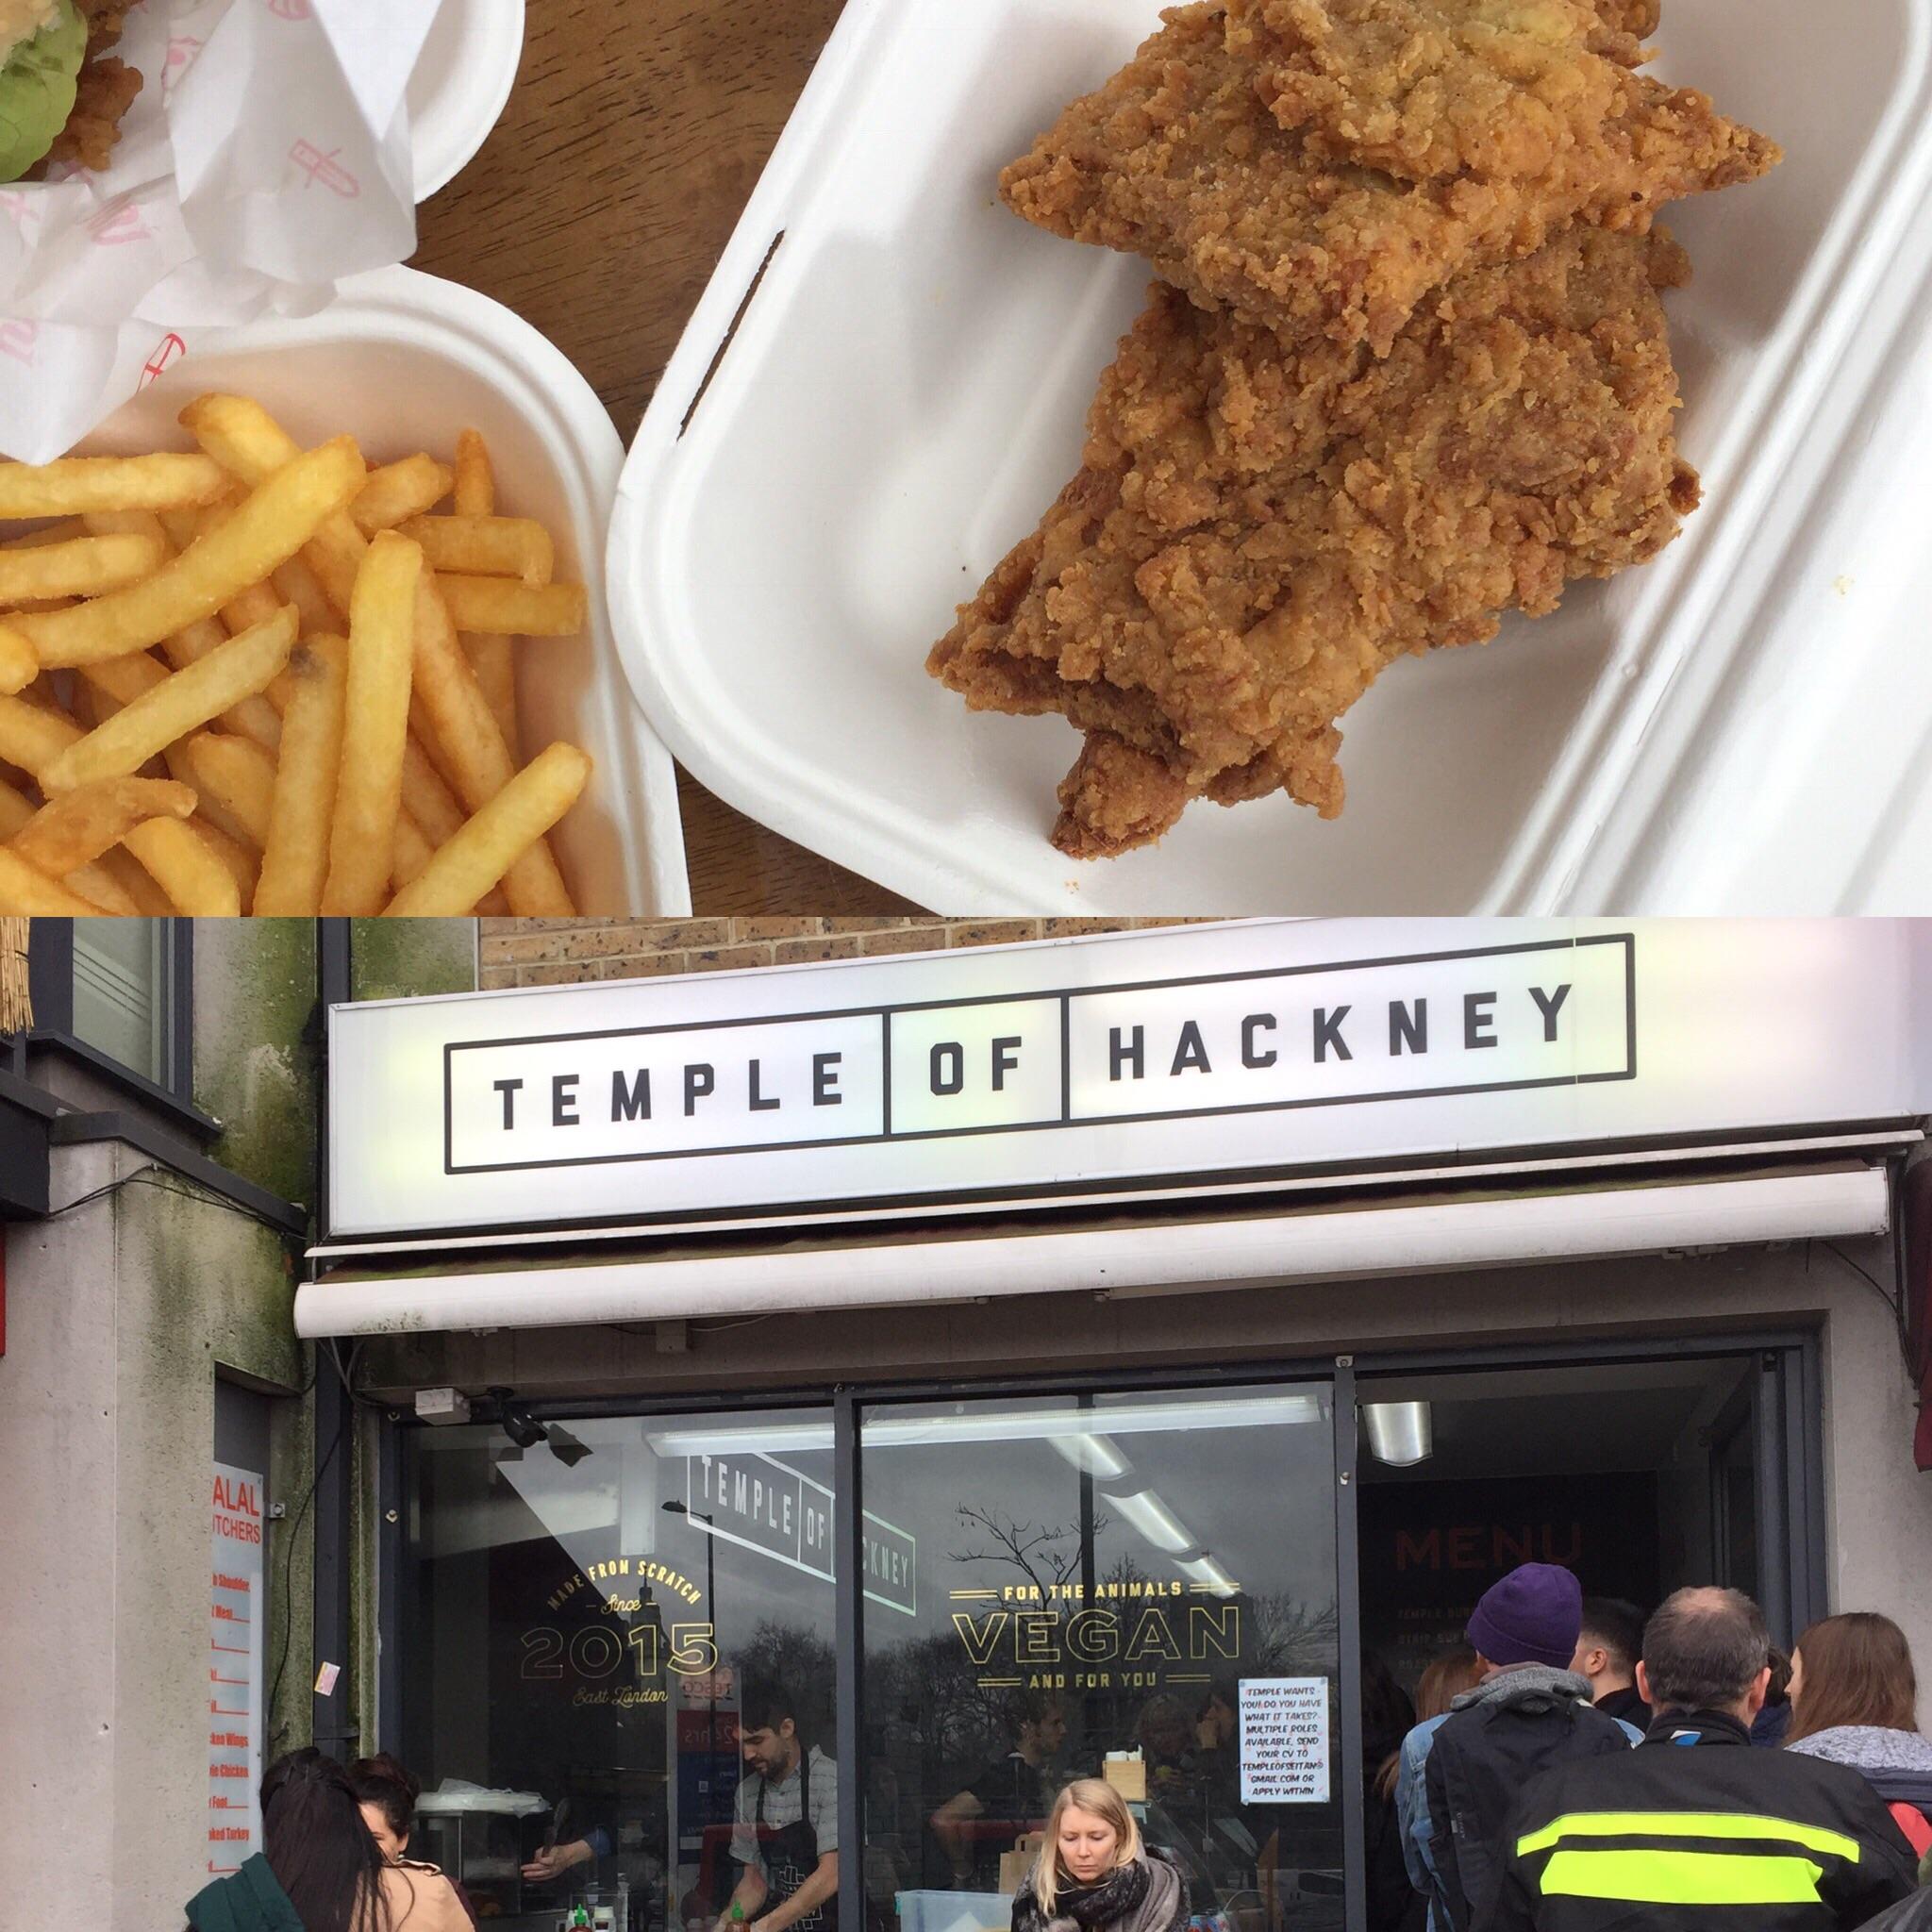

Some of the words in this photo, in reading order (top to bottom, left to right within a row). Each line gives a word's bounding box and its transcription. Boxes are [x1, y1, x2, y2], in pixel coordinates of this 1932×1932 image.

[493, 1052, 841, 1130] TEMPLE
[929, 1036, 1022, 1096] OF
[1108, 984, 1572, 1081] HACKNEY
[702, 1455, 792, 1535] TEMPLE
[807, 1507, 824, 1549] OF
[1396, 1523, 1583, 1571] MENU
[547, 1574, 585, 1610] MADE
[588, 1559, 629, 1581] FROM
[638, 1560, 702, 1605] SCRATCH
[1005, 1584, 1039, 1601] FOR
[1048, 1583, 1084, 1599] THE
[1094, 1582, 1183, 1598] ANIMALS
[601, 1593, 642, 1615] Since
[952, 1606, 1240, 1664] VEGAN
[521, 1623, 718, 1679] 2015
[1029, 1674, 1065, 1689] AND
[1075, 1673, 1110, 1688] FOR
[1122, 1672, 1158, 1686] YOU
[573, 1687, 608, 1707] East
[611, 1685, 669, 1708] London
[1247, 1688, 1281, 1696] TEMPLE
[1283, 1687, 1315, 1695] WANTS
[1264, 1700, 1276, 1708] DO
[1278, 1699, 1296, 1708] YOU
[1298, 1698, 1322, 1707] HAVE
[1245, 1712, 1270, 1722] WHAT
[1273, 1712, 1282, 1722] IT
[1285, 1711, 1317, 1722] TAKES?
[1246, 1724, 1288, 1734] MULTIPLE
[1291, 1724, 1318, 1734] ROLES
[1296, 1737, 1319, 1745] SEND
[1256, 1750, 1279, 1758] YOUR
[1281, 1750, 1293, 1758] CV
[1296, 1749, 1308, 1757] TO
[1302, 1774, 1314, 1782] OR
[1252, 1787, 1280, 1795] APPLY
[1283, 1787, 1314, 1795] WITHIN
